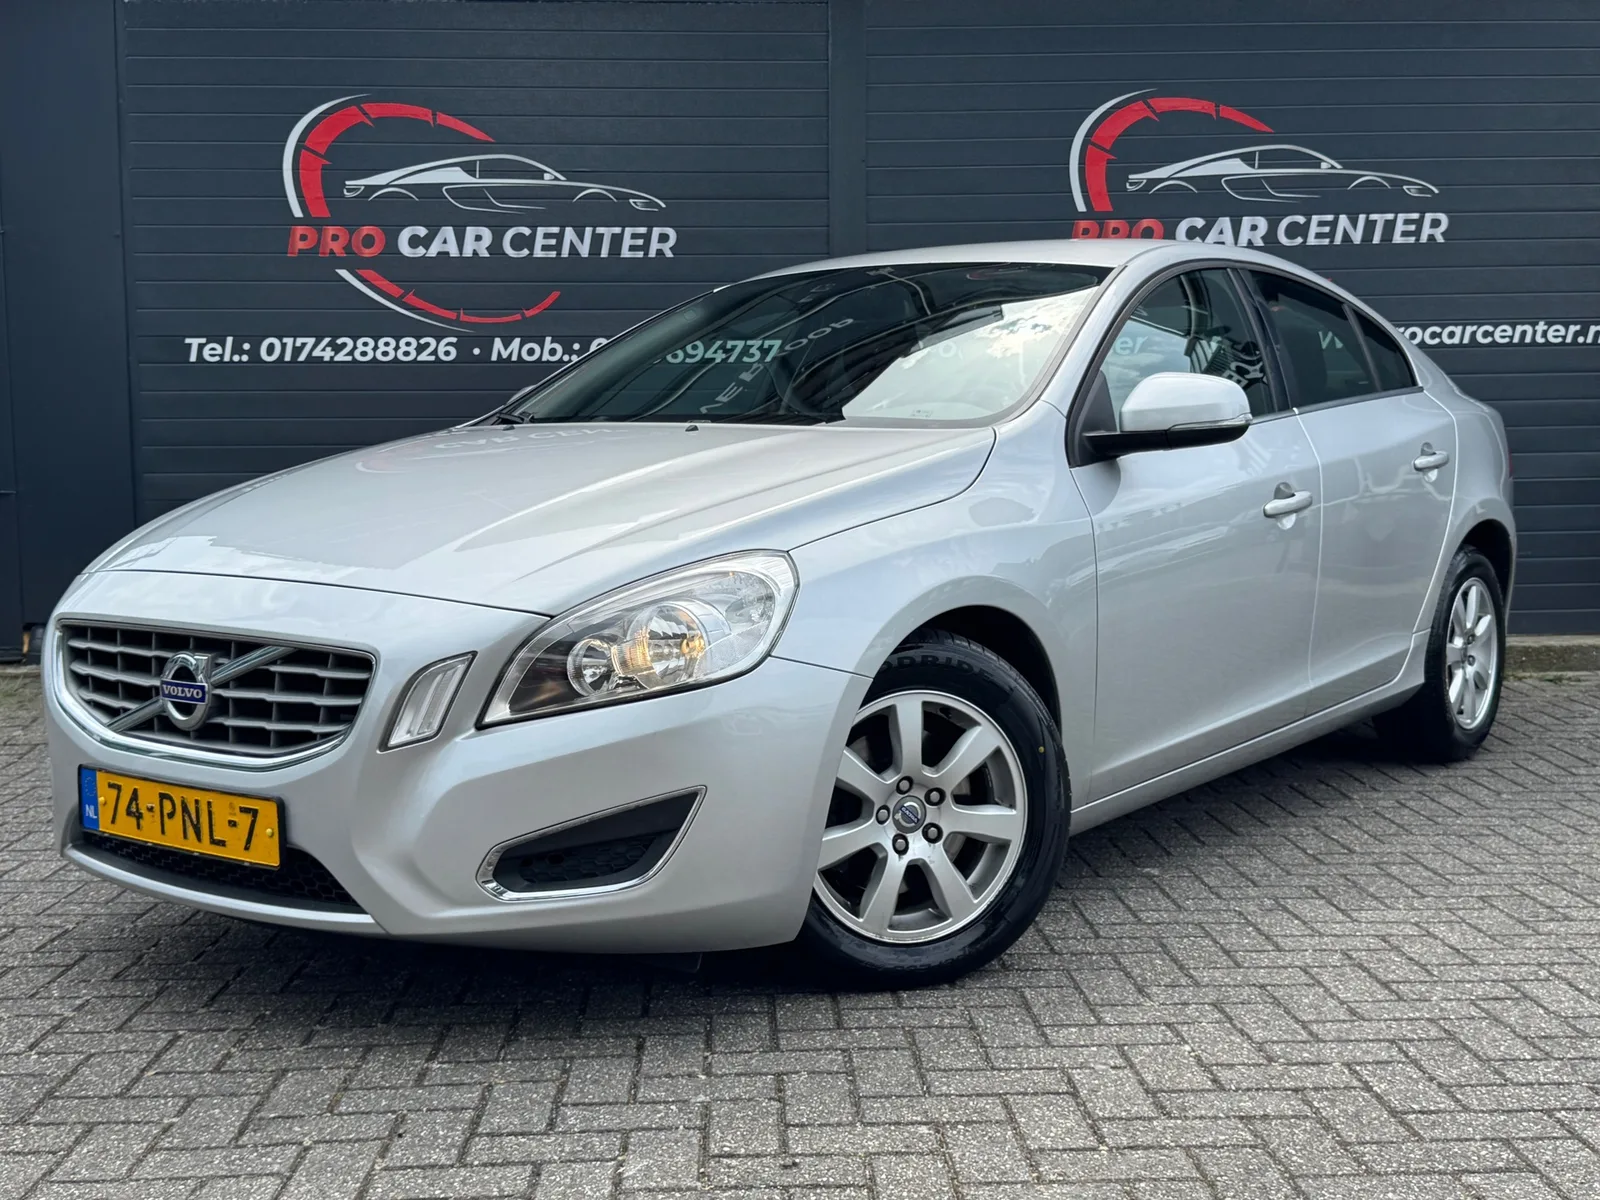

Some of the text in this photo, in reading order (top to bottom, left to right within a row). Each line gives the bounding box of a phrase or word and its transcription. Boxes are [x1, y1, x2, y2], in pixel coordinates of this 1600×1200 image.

[287, 225, 678, 258] PRO CAR CENTER
[1071, 212, 1449, 247] PRO CAR CENTER
[184, 336, 251, 363] Tel.:
[259, 336, 458, 362] 0174288826
[490, 336, 581, 362] Mob.:
[162, 684, 203, 699] VOLVO
[85, 804, 98, 819] NL
[107, 781, 259, 851] 74-PNL-7
